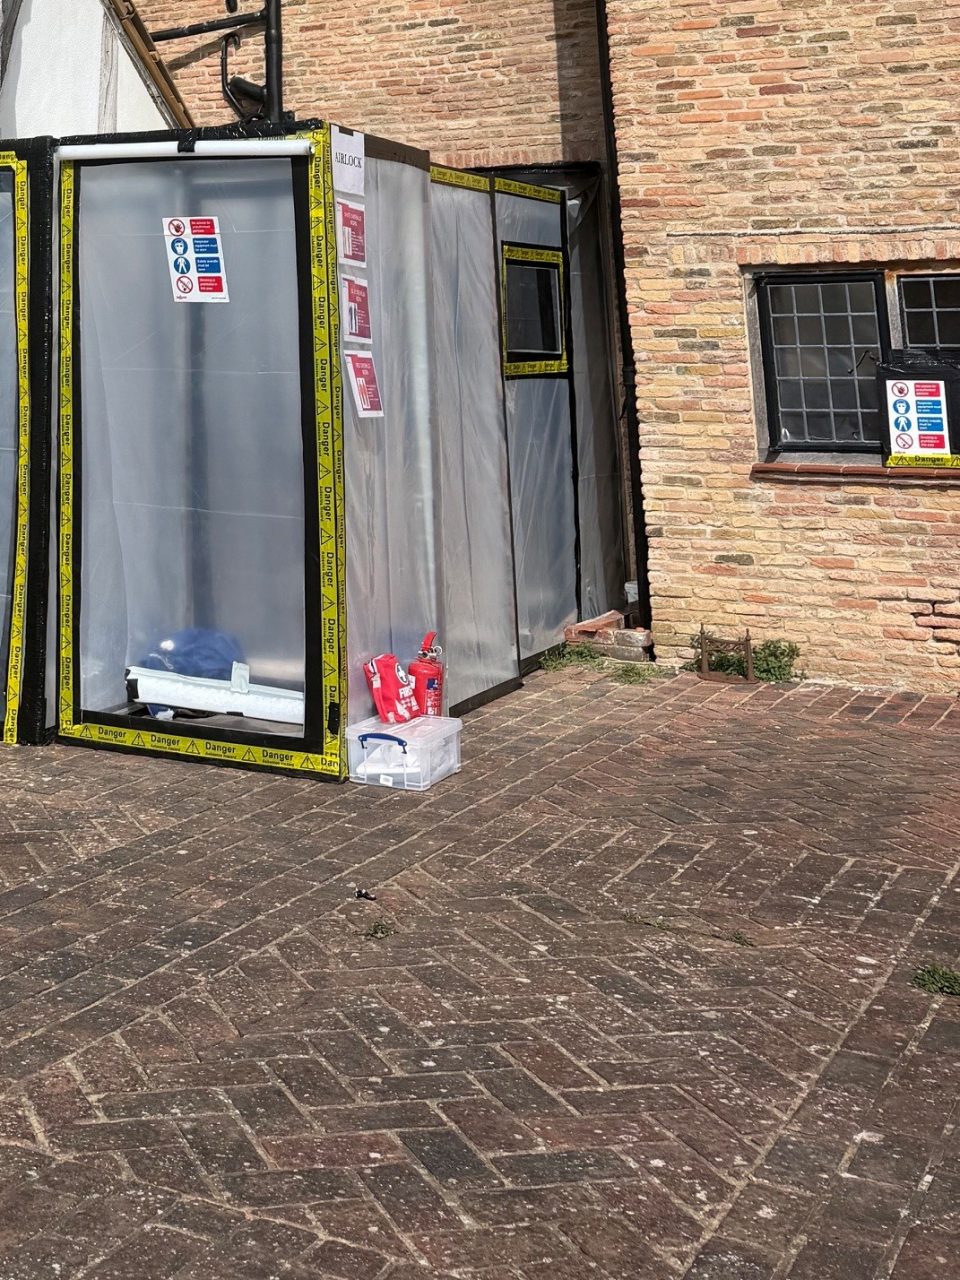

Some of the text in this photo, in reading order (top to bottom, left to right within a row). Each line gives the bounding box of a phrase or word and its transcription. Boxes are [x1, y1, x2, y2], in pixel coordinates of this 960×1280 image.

[335, 152, 362, 168] AIRLOCK
[316, 235, 324, 268] Danger
[318, 296, 326, 330] Danger
[320, 358, 328, 392] Danger
[322, 422, 330, 456] Danger
[324, 486, 332, 522] Danger
[326, 552, 334, 587] Danger
[328, 618, 336, 654] Danger
[13, 646, 21, 680] Danger
[9, 709, 17, 743] Danger
[98, 727, 126, 739] Danger
[150, 734, 180, 747] Danger
[205, 742, 236, 754] Danger
[262, 749, 294, 761] Danger
